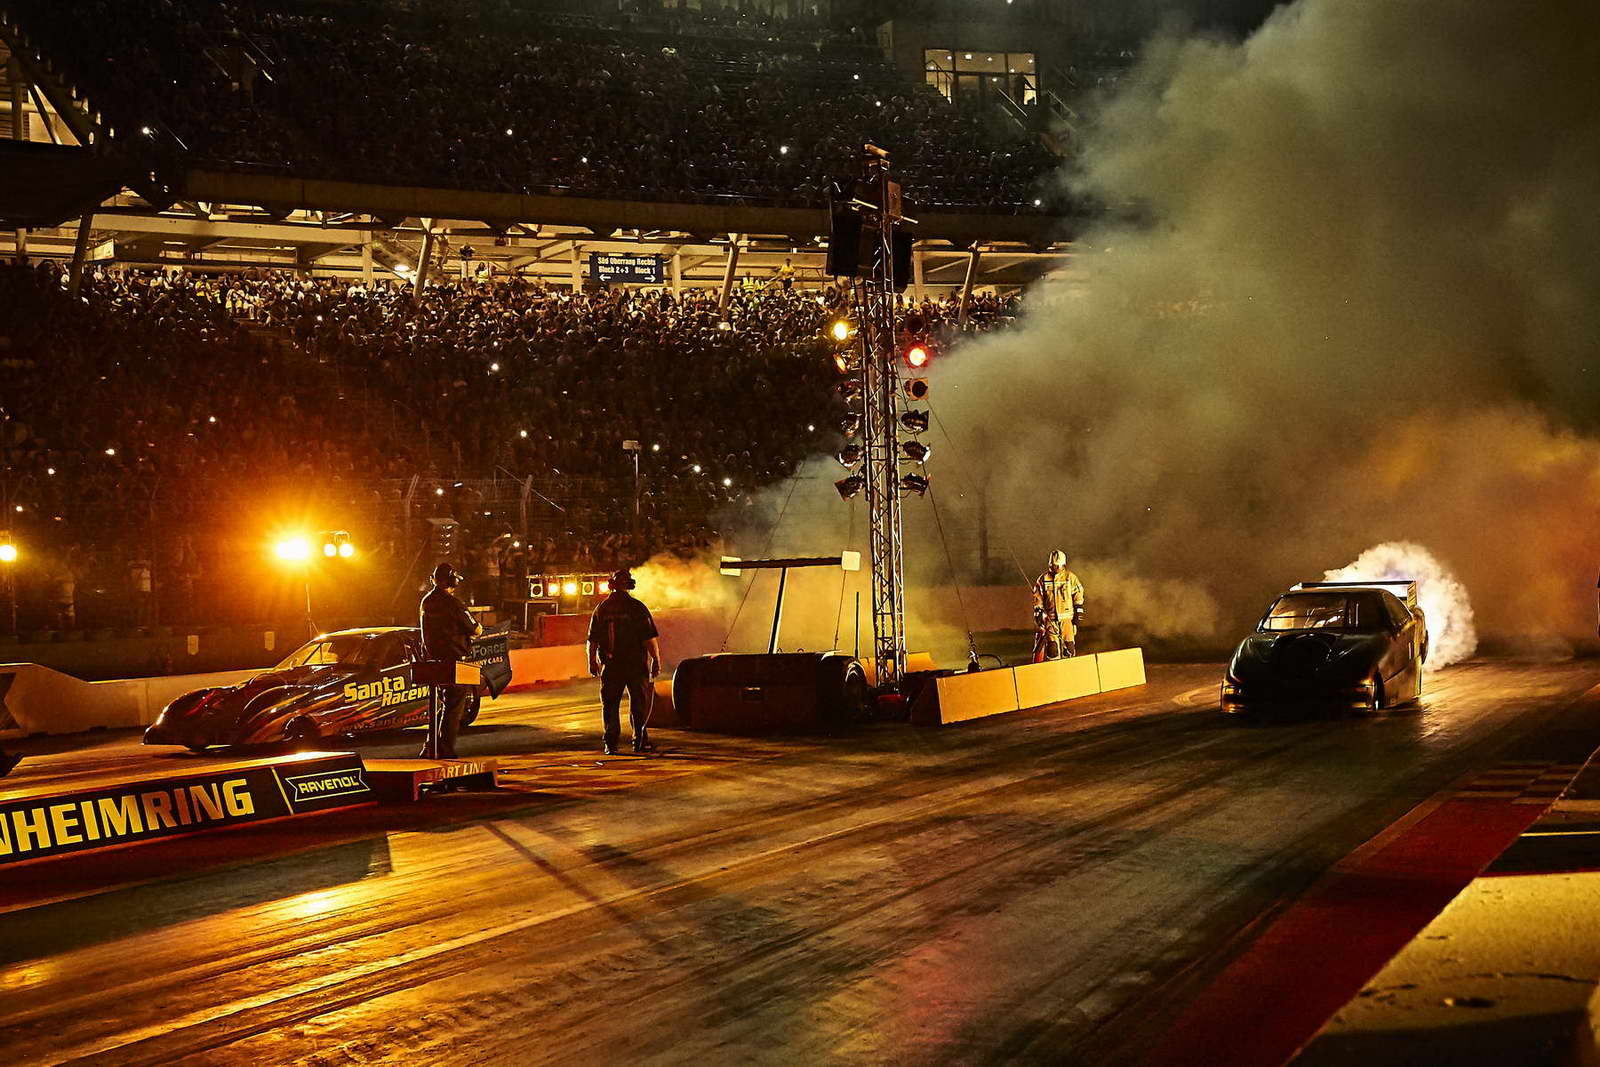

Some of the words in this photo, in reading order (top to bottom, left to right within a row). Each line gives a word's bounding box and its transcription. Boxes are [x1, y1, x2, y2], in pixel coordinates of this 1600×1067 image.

[610, 257, 636, 266] Oberrang
[598, 266, 615, 274] Block
[615, 266, 629, 274] 2+3
[635, 267, 651, 275] Block
[344, 677, 405, 703] Santa
[463, 762, 486, 775] LINE
[299, 776, 359, 794] RAVENOL
